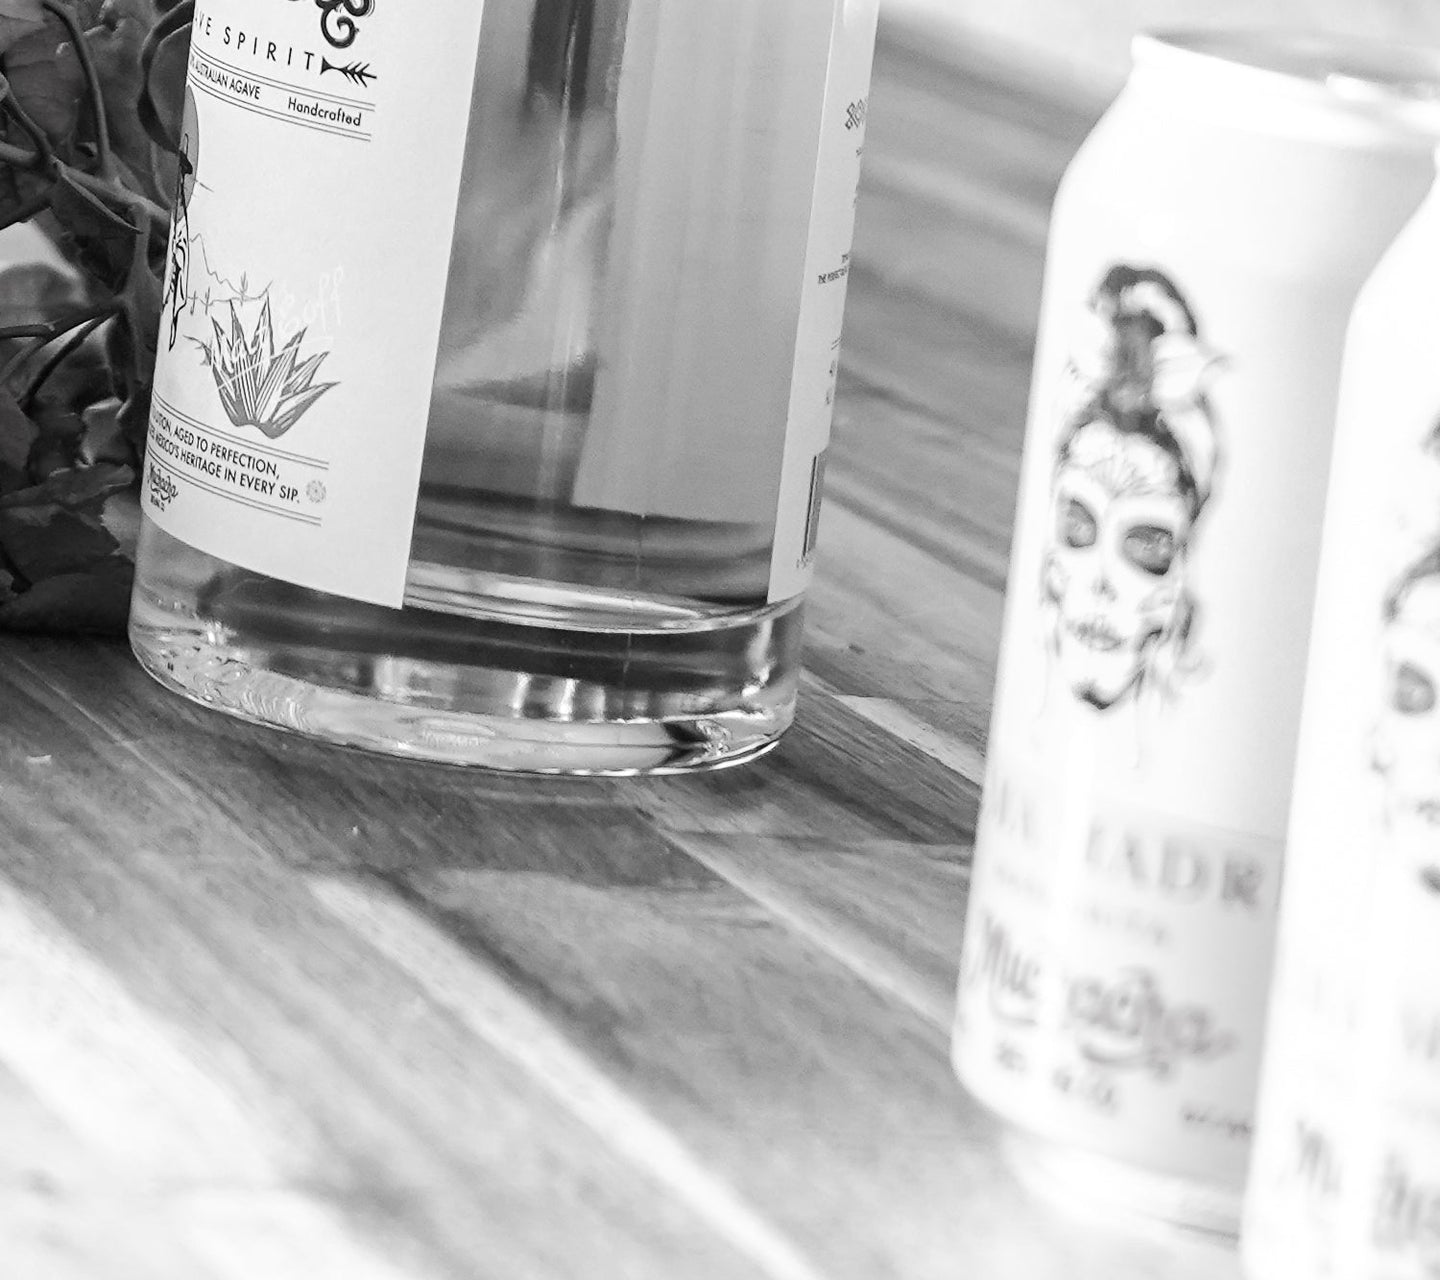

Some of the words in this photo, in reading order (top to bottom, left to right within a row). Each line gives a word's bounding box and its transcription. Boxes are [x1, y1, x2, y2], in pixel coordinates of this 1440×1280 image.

[195, 11, 213, 36] VE
[223, 25, 315, 71] SPIRIT
[229, 78, 261, 100] AGAVE
[288, 96, 362, 127] Handcrafted
[173, 425, 194, 447] AGED
[195, 438, 208, 453] TO
[210, 442, 281, 480] PERFECTION,
[180, 449, 221, 479] HERITAGE
[224, 467, 236, 484] IN
[240, 473, 276, 497] EVERY
[279, 485, 301, 504] SIP.
